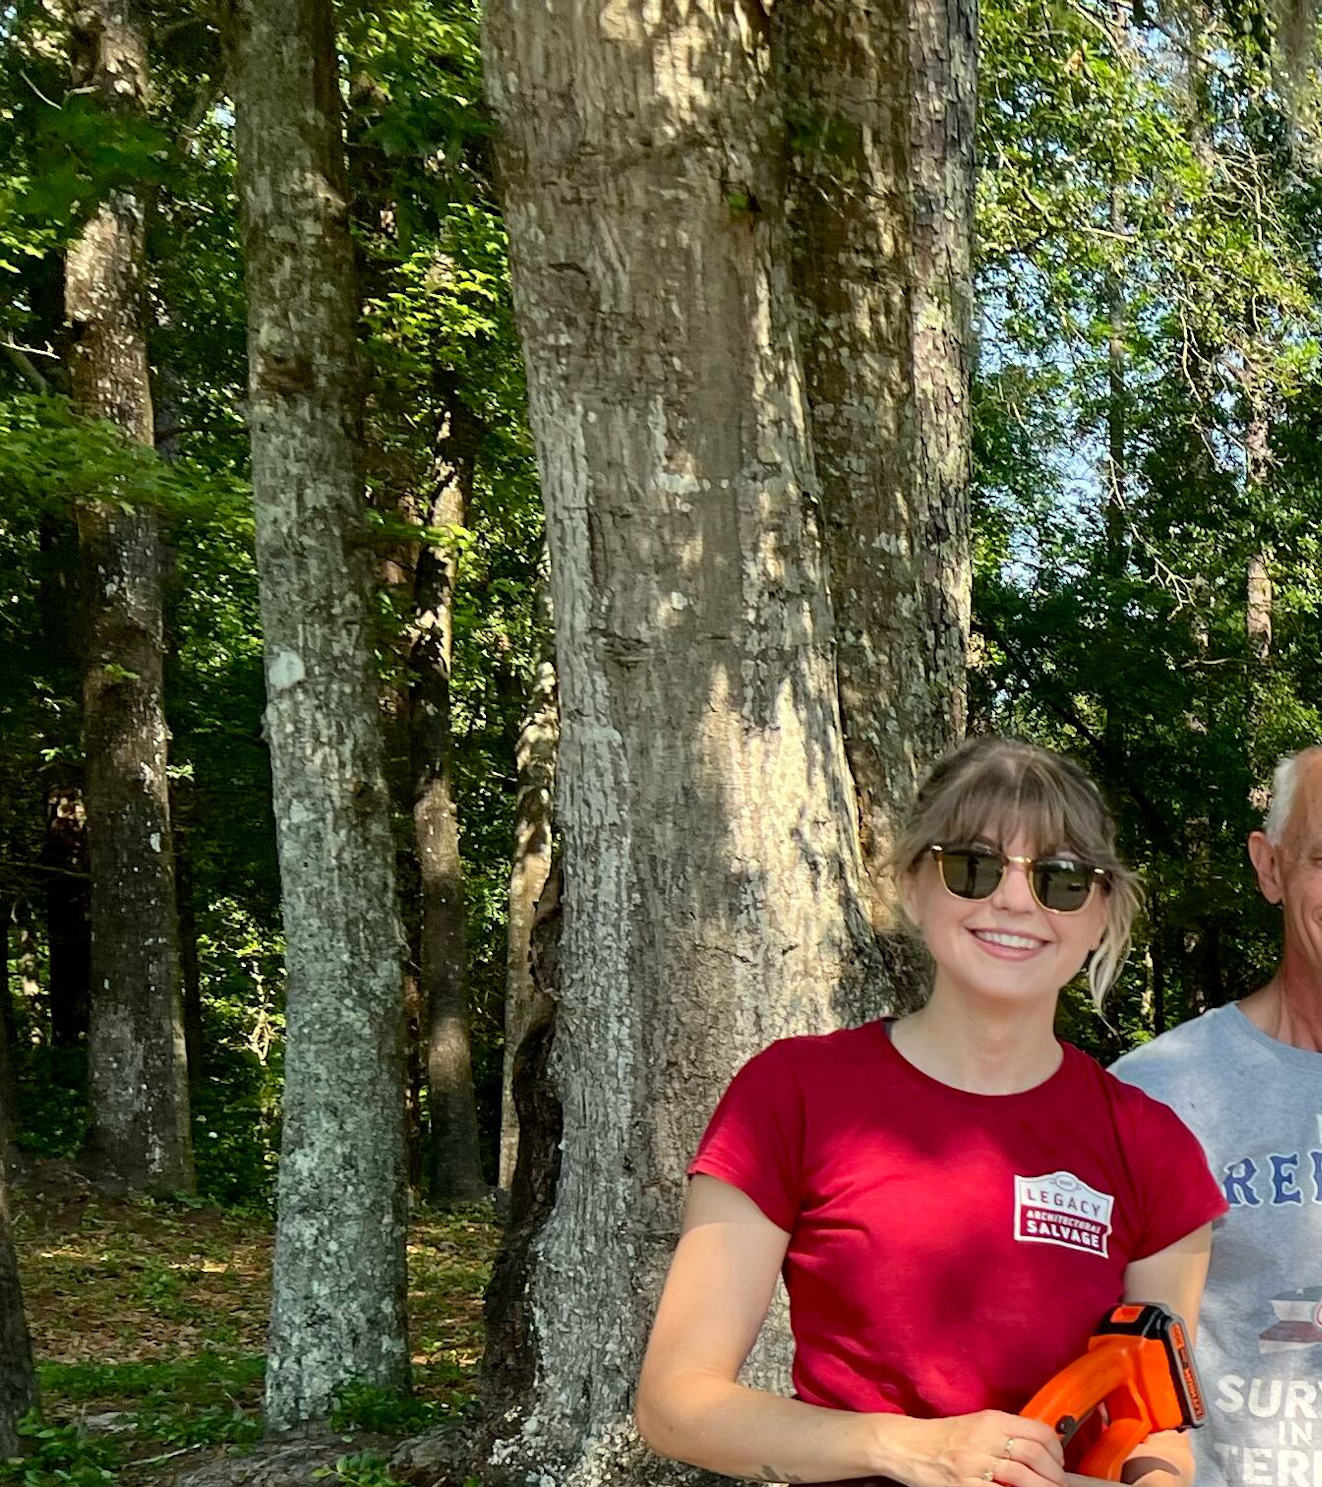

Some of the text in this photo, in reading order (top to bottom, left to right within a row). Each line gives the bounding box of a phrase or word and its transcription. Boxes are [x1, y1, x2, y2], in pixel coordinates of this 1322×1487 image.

[1027, 1188, 1100, 1217] LEGACY
[1026, 1220, 1100, 1248] SALVAGE
[1278, 1421, 1312, 1446] IN
